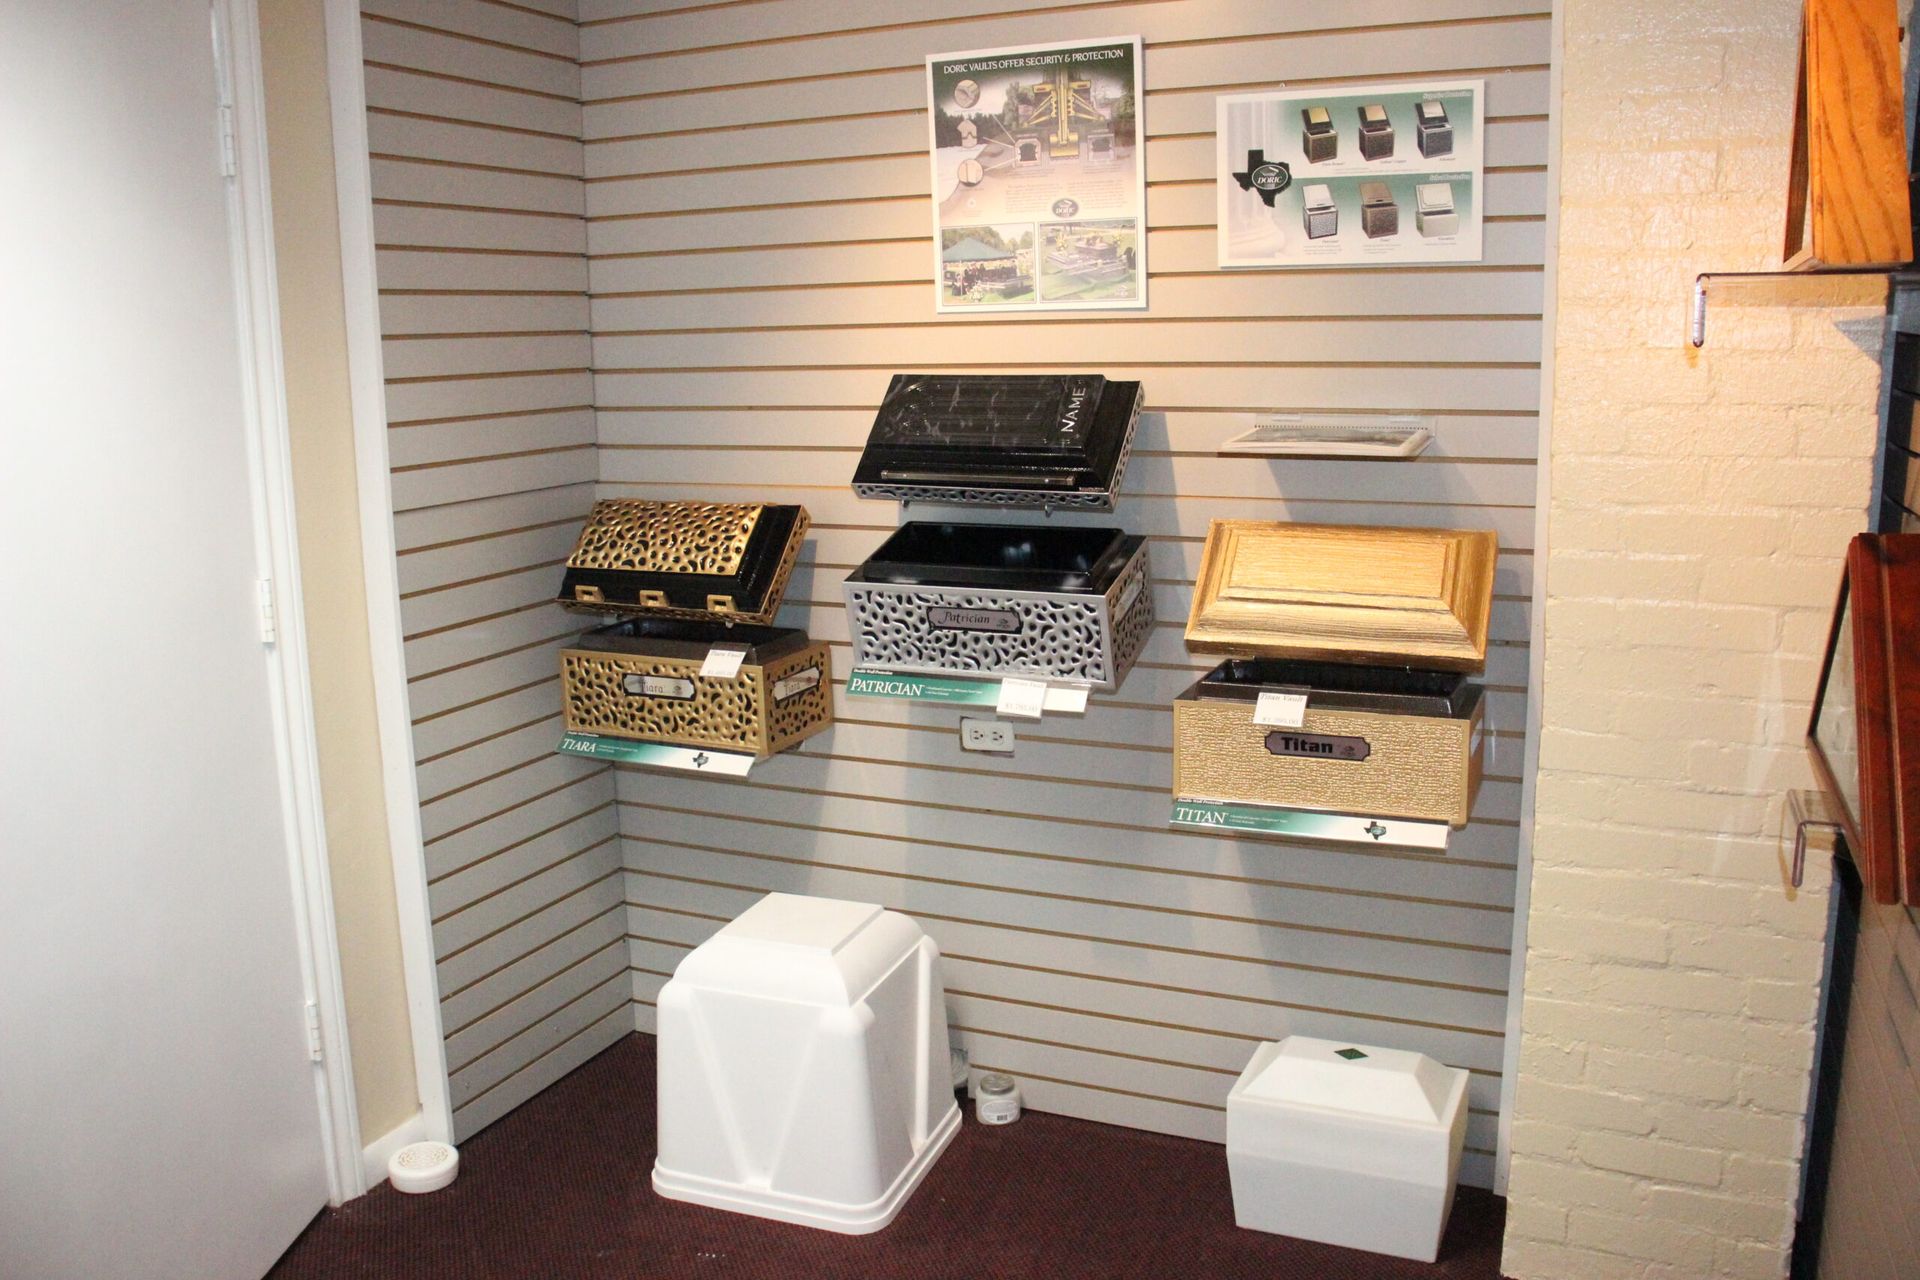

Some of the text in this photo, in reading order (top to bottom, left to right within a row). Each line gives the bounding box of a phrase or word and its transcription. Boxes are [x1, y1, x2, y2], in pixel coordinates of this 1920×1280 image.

[944, 49, 1124, 74] DORIC VAULTS OFFER SECURITY & PROTECTION
[1257, 176, 1281, 184] DORIC
[1061, 387, 1086, 432] NAME
[938, 611, 990, 624] Patrician
[640, 681, 665, 693] Tiara
[850, 678, 923, 697] PATRICIAN
[562, 738, 597, 753] TIARA
[1281, 737, 1333, 753] Titan
[1176, 808, 1227, 824] TITAN
